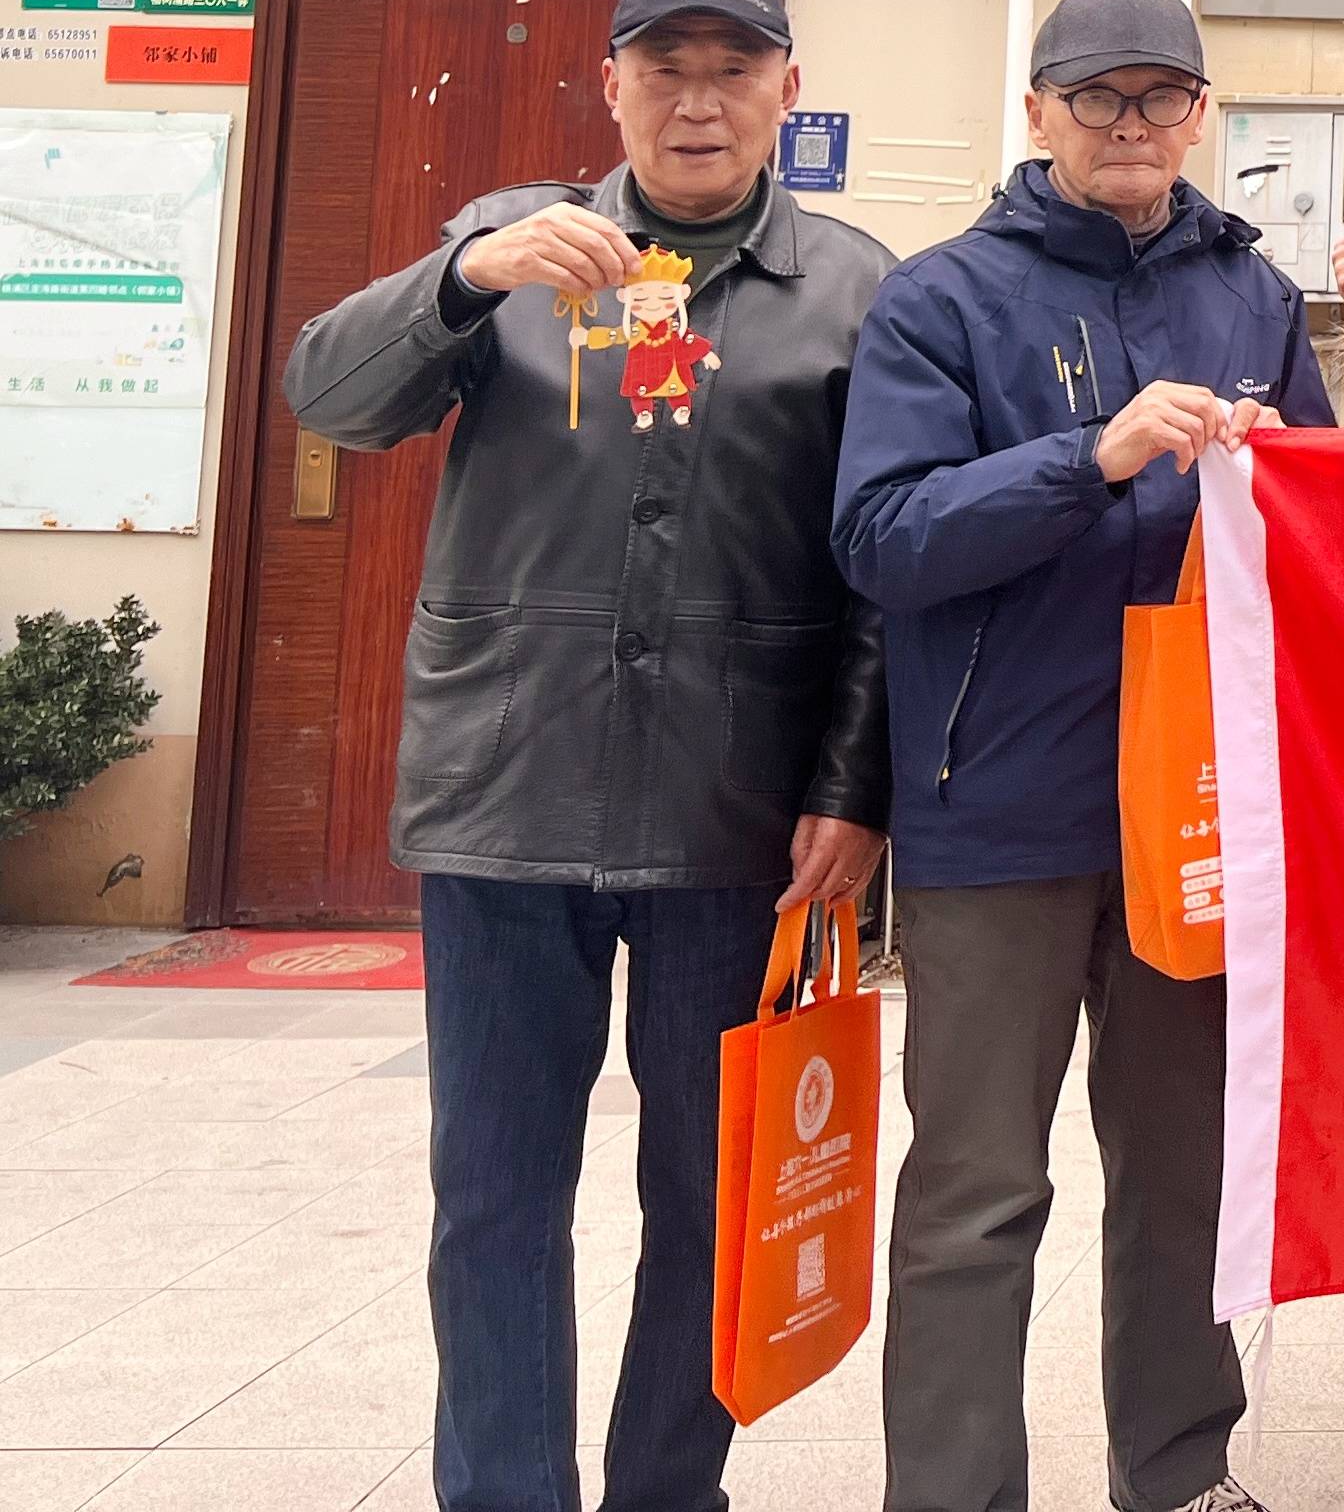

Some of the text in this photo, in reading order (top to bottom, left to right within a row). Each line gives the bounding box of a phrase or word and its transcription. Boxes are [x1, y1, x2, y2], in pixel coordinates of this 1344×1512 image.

[44, 48, 97, 60] 65670011
[143, 45, 218, 64] 邻家小铺
[75, 376, 159, 394] 从我做起
